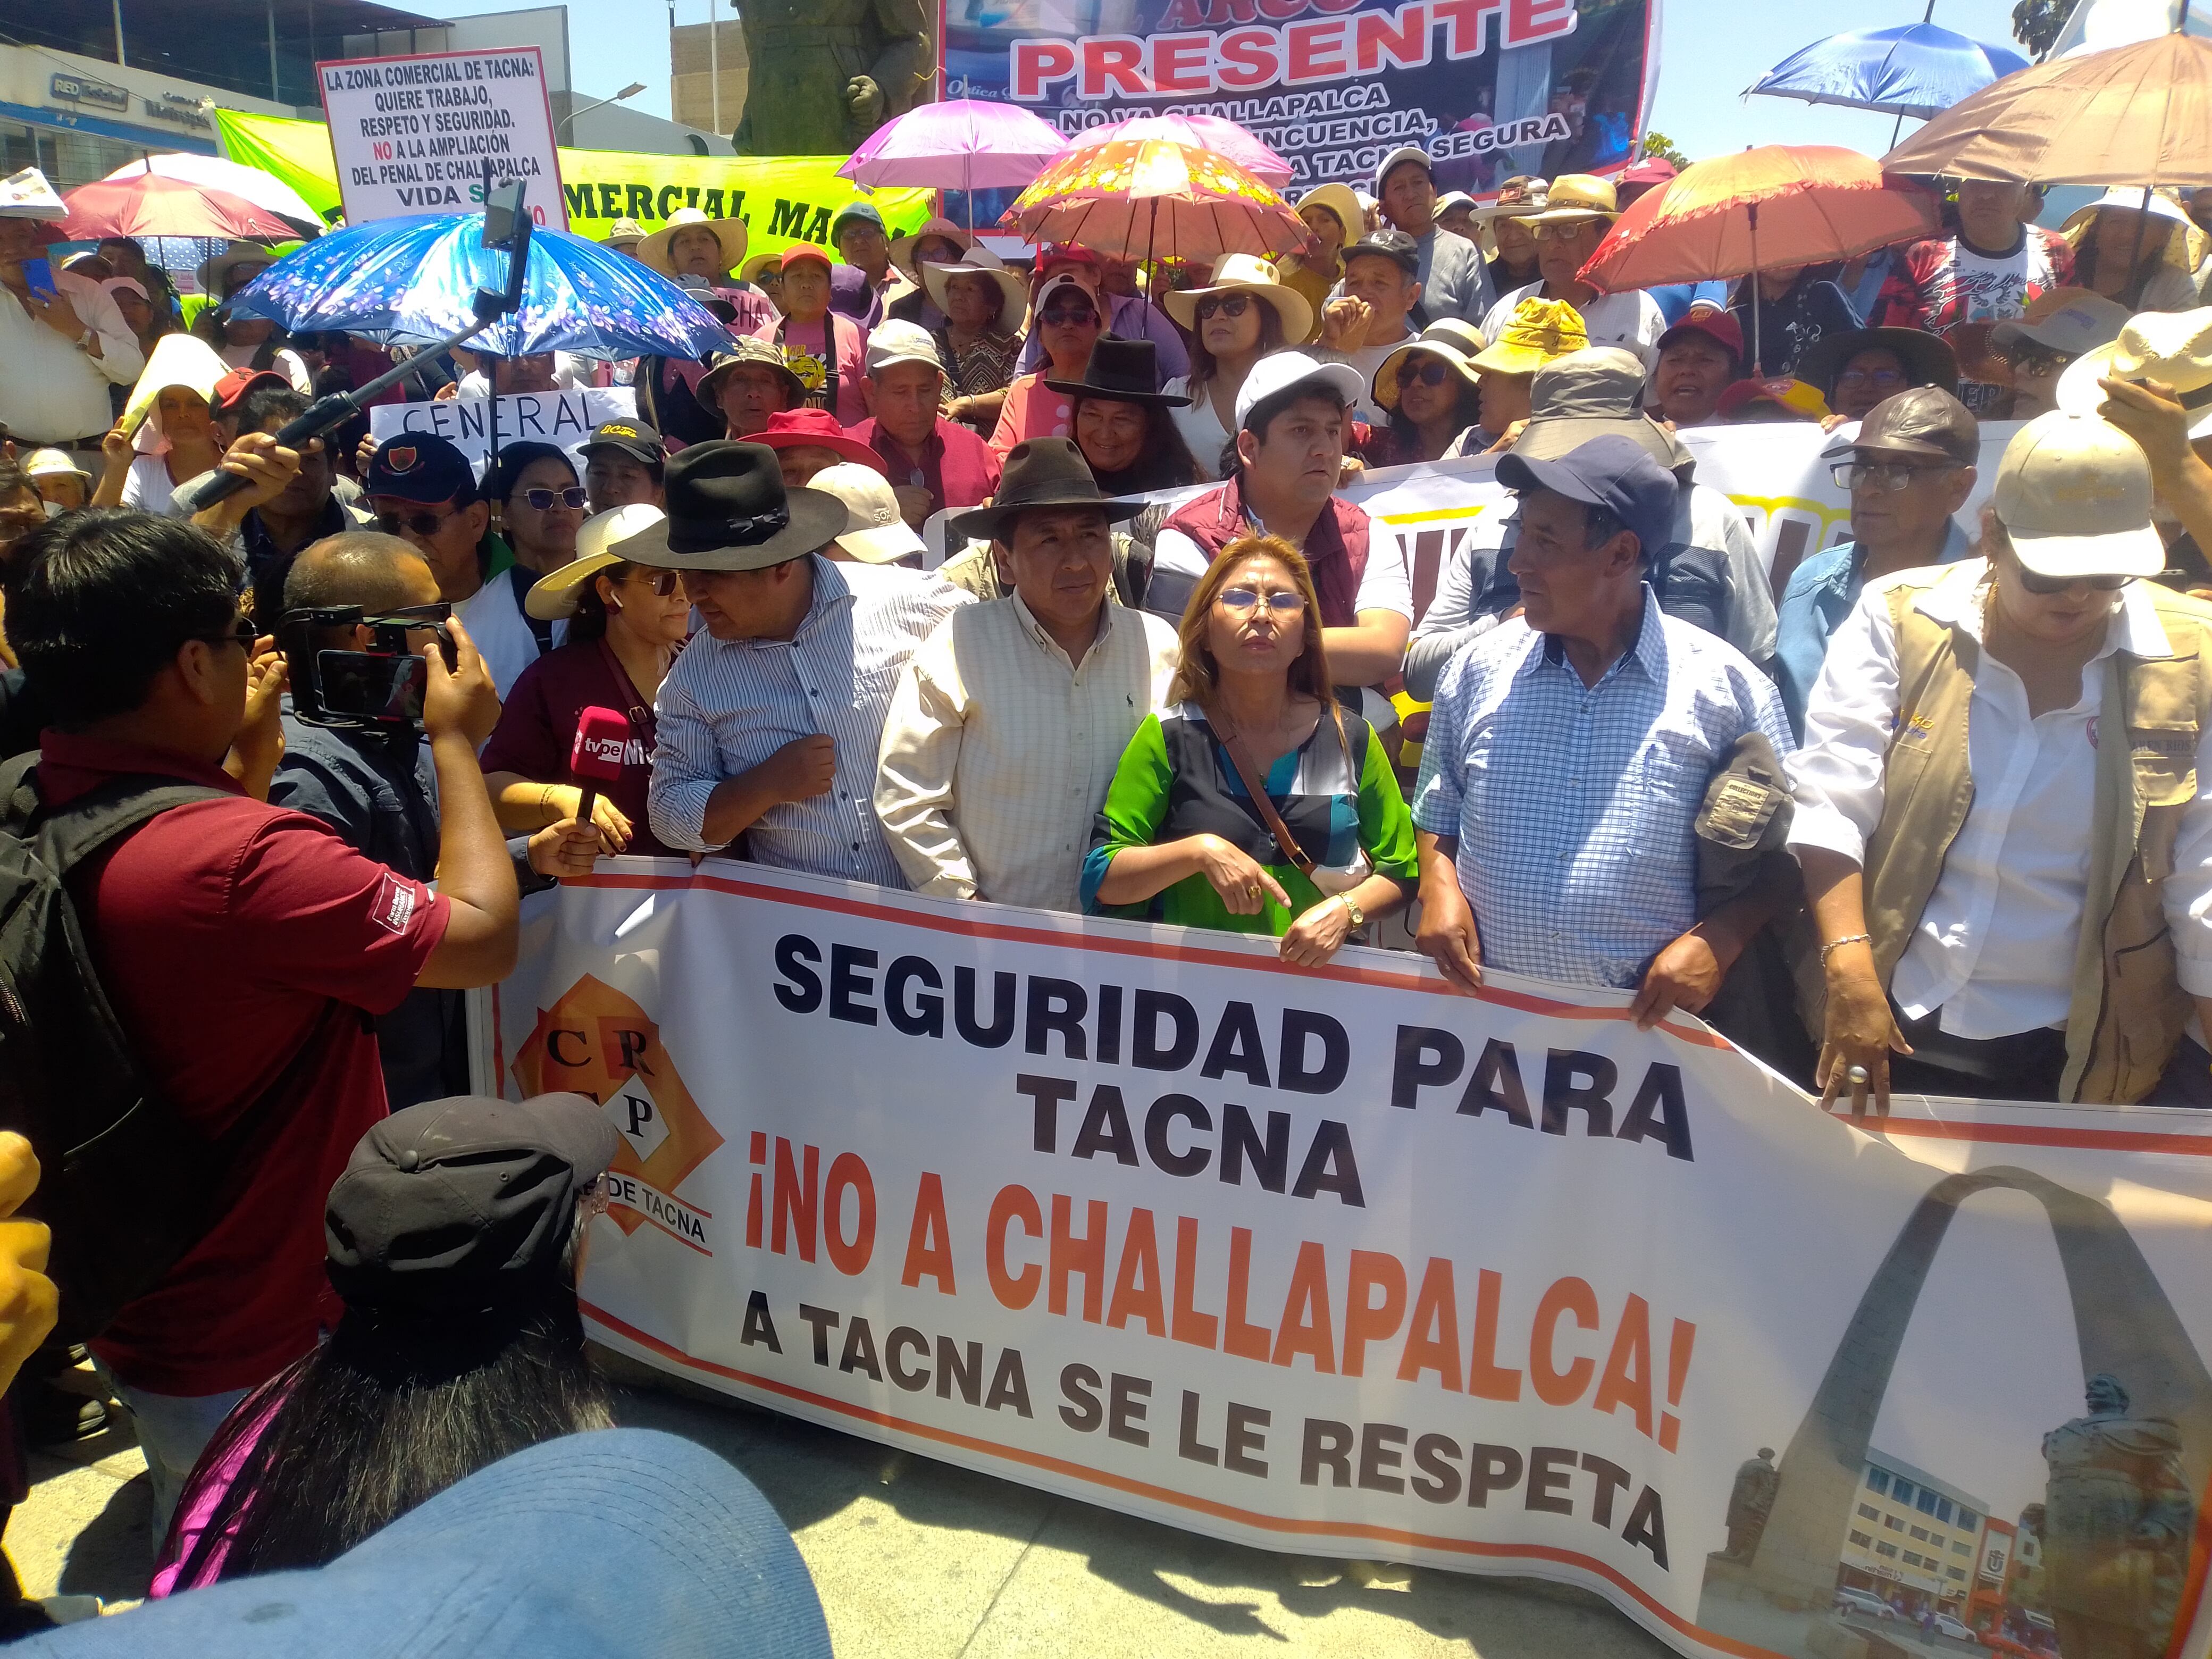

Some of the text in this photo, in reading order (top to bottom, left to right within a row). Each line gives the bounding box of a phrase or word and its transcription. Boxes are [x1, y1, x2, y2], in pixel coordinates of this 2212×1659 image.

[1016, 0, 1573, 97] PRESENTE
[326, 57, 534, 91] LA ZONA COMERCIAL DE TACNA:
[948, 80, 997, 98] Otica
[375, 85, 492, 112] QUIERE TRABAJO,
[360, 109, 515, 137] RESPETO Y SEGURIDAD.
[1064, 111, 1105, 131] NO
[1432, 116, 1567, 158] SEGURA
[373, 129, 510, 160] NO A LA AMPLIACIÓN
[352, 156, 541, 186] DEL PENAL DE CHALAPALCA
[396, 185, 462, 206] VIDA
[547, 1029, 655, 1076] C R
[773, 934, 1695, 1162] SEGURIDAD PARA
[623, 1094, 653, 1137] P
[1016, 1073, 1366, 1208] TACNA
[609, 1177, 706, 1243] DE TACNA
[746, 1130, 1697, 1455] ¡NO A CHALLAPALCA!
[740, 1290, 1670, 1572] A TACNA SE LE RESPETA
